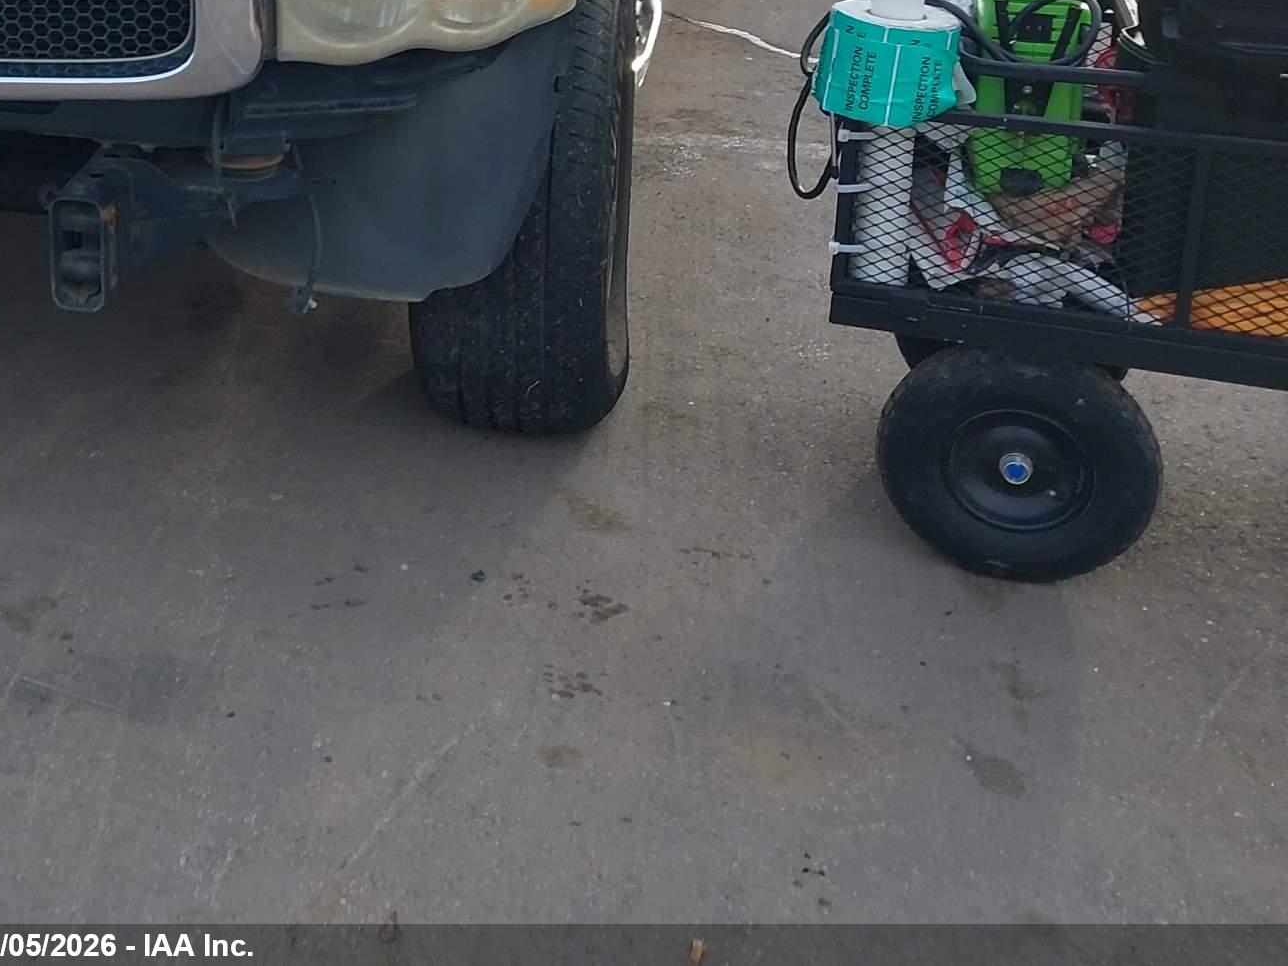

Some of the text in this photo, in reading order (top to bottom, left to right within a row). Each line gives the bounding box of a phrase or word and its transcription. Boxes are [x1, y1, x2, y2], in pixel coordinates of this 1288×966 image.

[844, 45, 864, 112] INSPECTION
[858, 51, 878, 110] COMPLETE
[912, 56, 932, 122] INSPECTION
[926, 59, 943, 118] COMPLETE
